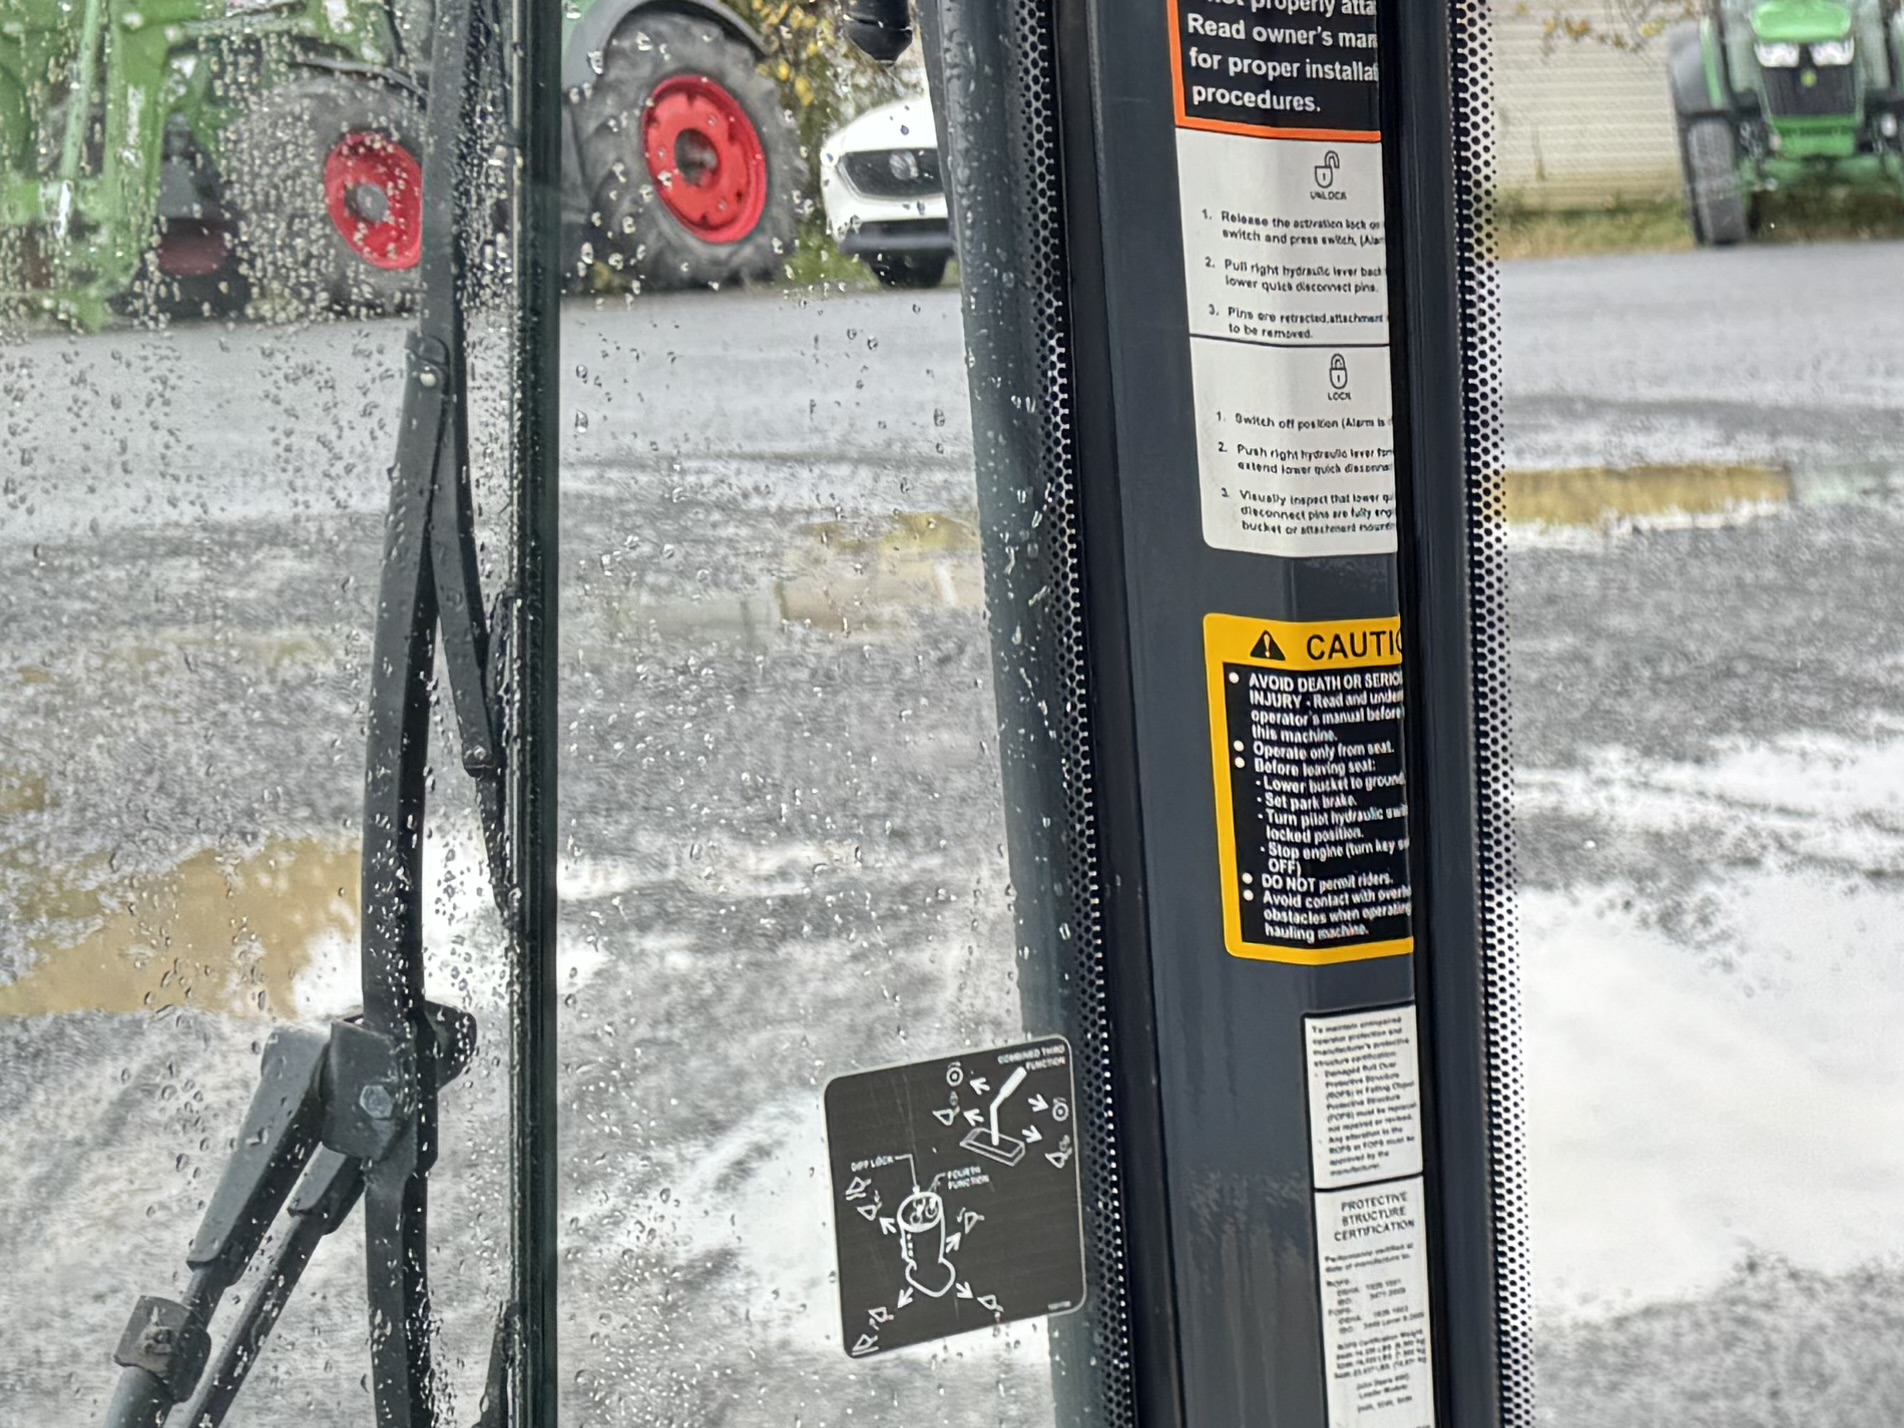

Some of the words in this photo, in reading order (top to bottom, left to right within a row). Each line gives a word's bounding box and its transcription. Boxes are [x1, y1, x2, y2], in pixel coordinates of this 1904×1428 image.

[1187, 13, 1246, 39] Read
[1252, 26, 1333, 46] owner's
[1189, 47, 1222, 69] for
[1228, 56, 1301, 81] proper
[1192, 85, 1321, 112] procedures.
[1202, 209, 1212, 220] 1.
[1221, 211, 1269, 227] Release
[1272, 217, 1290, 228] the
[1222, 227, 1261, 242] switch
[1265, 231, 1287, 244] and
[1290, 236, 1318, 246] press
[1205, 256, 1215, 268] 2.
[1225, 259, 1247, 271] Pull
[1251, 262, 1279, 276] right
[1282, 266, 1330, 278] hydraulic
[1333, 266, 1357, 276] lever
[1226, 275, 1258, 288] lower
[1262, 278, 1293, 293] quick
[1296, 280, 1351, 292] disconnect
[1354, 281, 1378, 294] pins.
[1228, 307, 1253, 320] Pins
[1258, 312, 1275, 323] are
[1229, 324, 1240, 333] to
[1244, 326, 1257, 335] be
[1262, 329, 1313, 338] removed.
[1328, 392, 1351, 400] LOCK
[1235, 413, 1275, 427] Switch
[1279, 419, 1295, 428] off
[1298, 419, 1338, 430] position
[1237, 444, 1267, 457] Push
[1271, 448, 1299, 461] right
[1301, 449, 1347, 461] hydraulic
[1351, 448, 1374, 457] lever
[1237, 461, 1277, 474] extend
[1281, 464, 1311, 475] lower
[1314, 464, 1341, 476] quick
[1240, 489, 1286, 506] Visually
[1290, 493, 1328, 507] inspect
[1331, 493, 1350, 503] that
[1241, 506, 1305, 520] disconnect
[1308, 510, 1329, 521] pins
[1333, 510, 1348, 519] are
[1242, 520, 1281, 534] bucket
[1286, 526, 1297, 534] or
[1249, 672, 1294, 690] AVOID
[1298, 672, 1341, 692] DEATH
[1343, 674, 1362, 689] OR
[1250, 689, 1302, 709] INJURY
[1313, 694, 1343, 709] Read
[1346, 692, 1367, 706] and
[1252, 710, 1320, 727] operator's
[1322, 708, 1365, 725] manual
[1252, 725, 1277, 740] this
[1281, 729, 1338, 743] machine.
[1253, 741, 1307, 761] Operate
[1310, 744, 1335, 761] only
[1338, 742, 1364, 756] from
[1367, 741, 1394, 755] seat.
[1254, 758, 1299, 777] Before
[1303, 761, 1346, 777] leaving
[1348, 760, 1376, 773] seat:
[1264, 776, 1306, 794] Lower
[1309, 778, 1348, 794] bucket
[1351, 777, 1363, 790] to
[1265, 793, 1287, 808] Set
[1291, 797, 1319, 812] park
[1265, 809, 1298, 826] Turn
[1302, 811, 1329, 828] pilot
[1331, 808, 1383, 825] hydraulic
[1266, 826, 1311, 843] locked
[1314, 827, 1364, 844] position.
[1268, 842, 1299, 861] Stop
[1303, 846, 1344, 862] engine
[1346, 842, 1373, 859] (turn
[1375, 839, 1395, 855] key
[1268, 858, 1302, 876] OFF)
[1262, 873, 1283, 889] DO
[1286, 877, 1316, 892] NOT
[1319, 875, 1355, 891] permit
[1358, 872, 1393, 886] riders.
[1263, 889, 1302, 908] Avoid
[1305, 892, 1349, 909] contact
[1351, 890, 1375, 903] with
[1263, 906, 1326, 925] obstacles
[1329, 908, 1360, 922] when
[1265, 923, 1315, 944] hauling
[870, 1156, 894, 1168] LOCK
[1341, 1191, 1408, 1212] PROTECTIVE
[1342, 1206, 1406, 1226] STRUCTURE
[1334, 1219, 1415, 1241] CERTIFICATION
